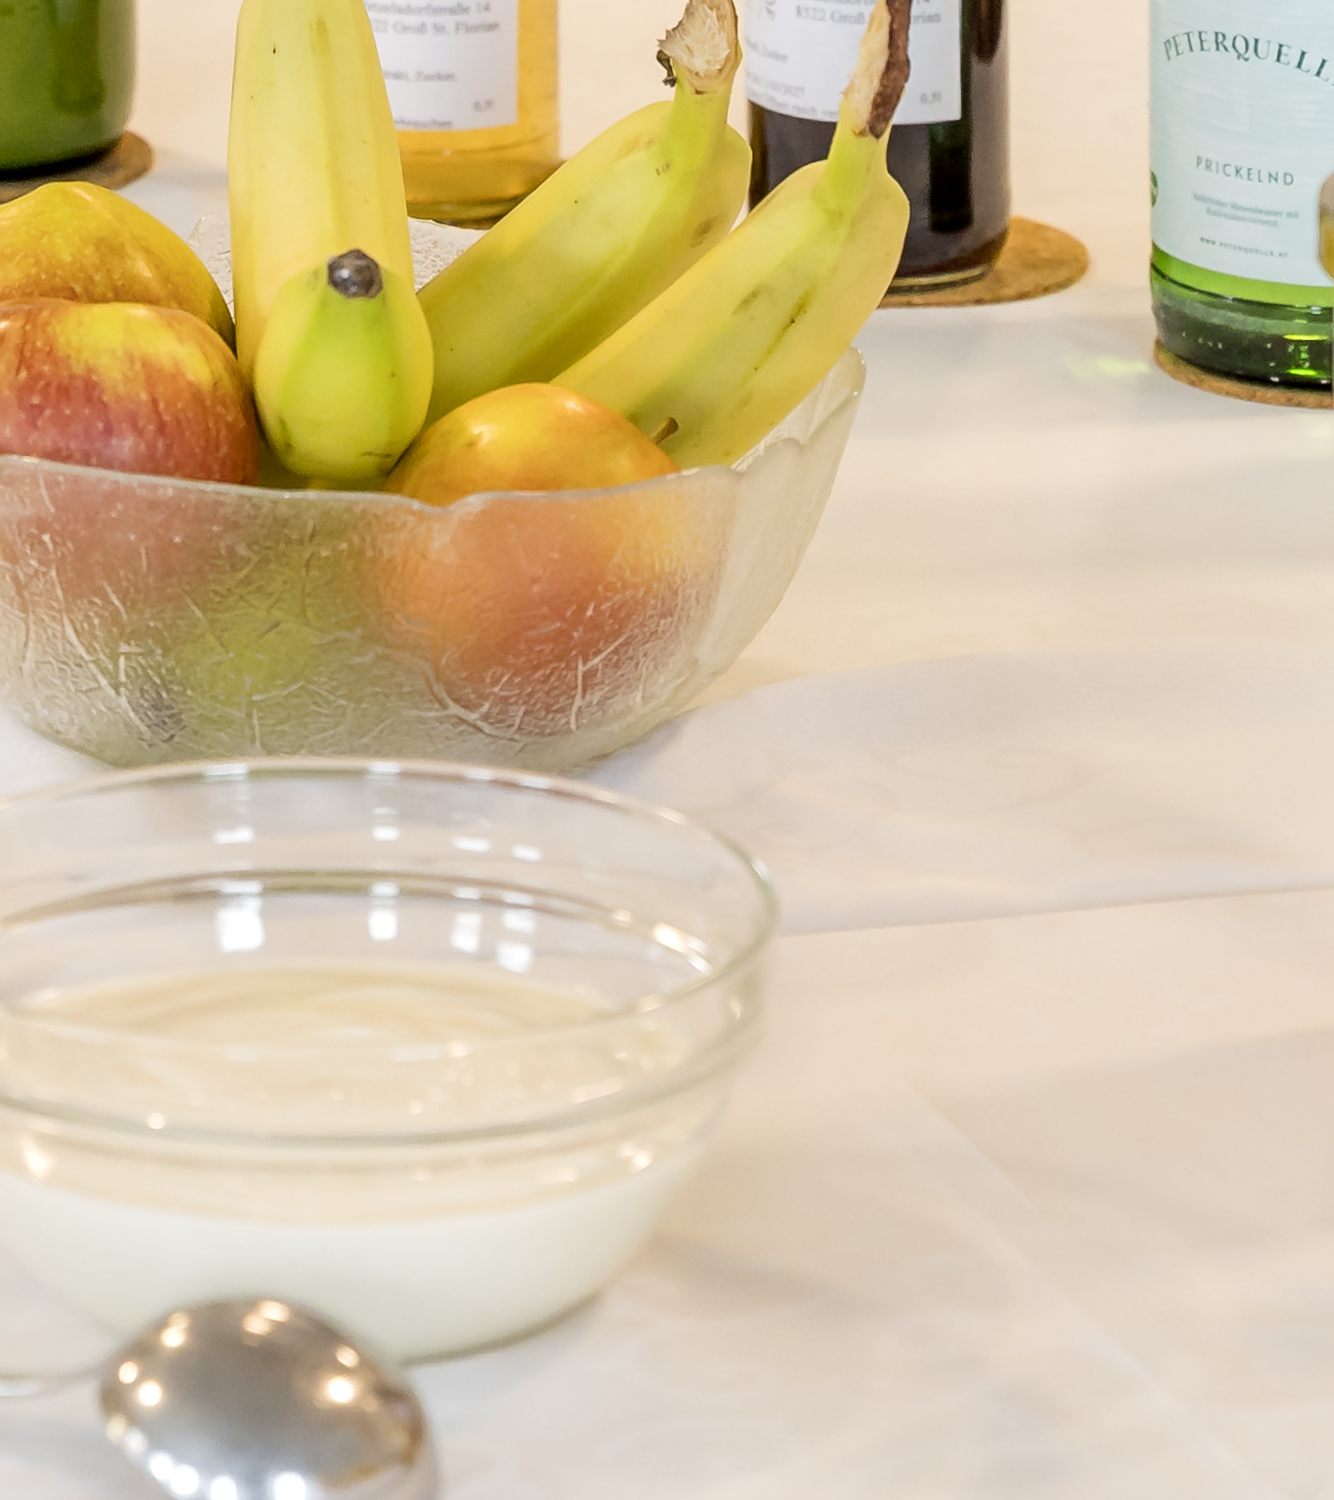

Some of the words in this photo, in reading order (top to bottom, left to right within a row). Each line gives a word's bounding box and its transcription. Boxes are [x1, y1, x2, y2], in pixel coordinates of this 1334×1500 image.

[475, 1, 490, 15] 14
[912, 12, 942, 25] rian
[1196, 155, 1295, 186] PRICKELND
